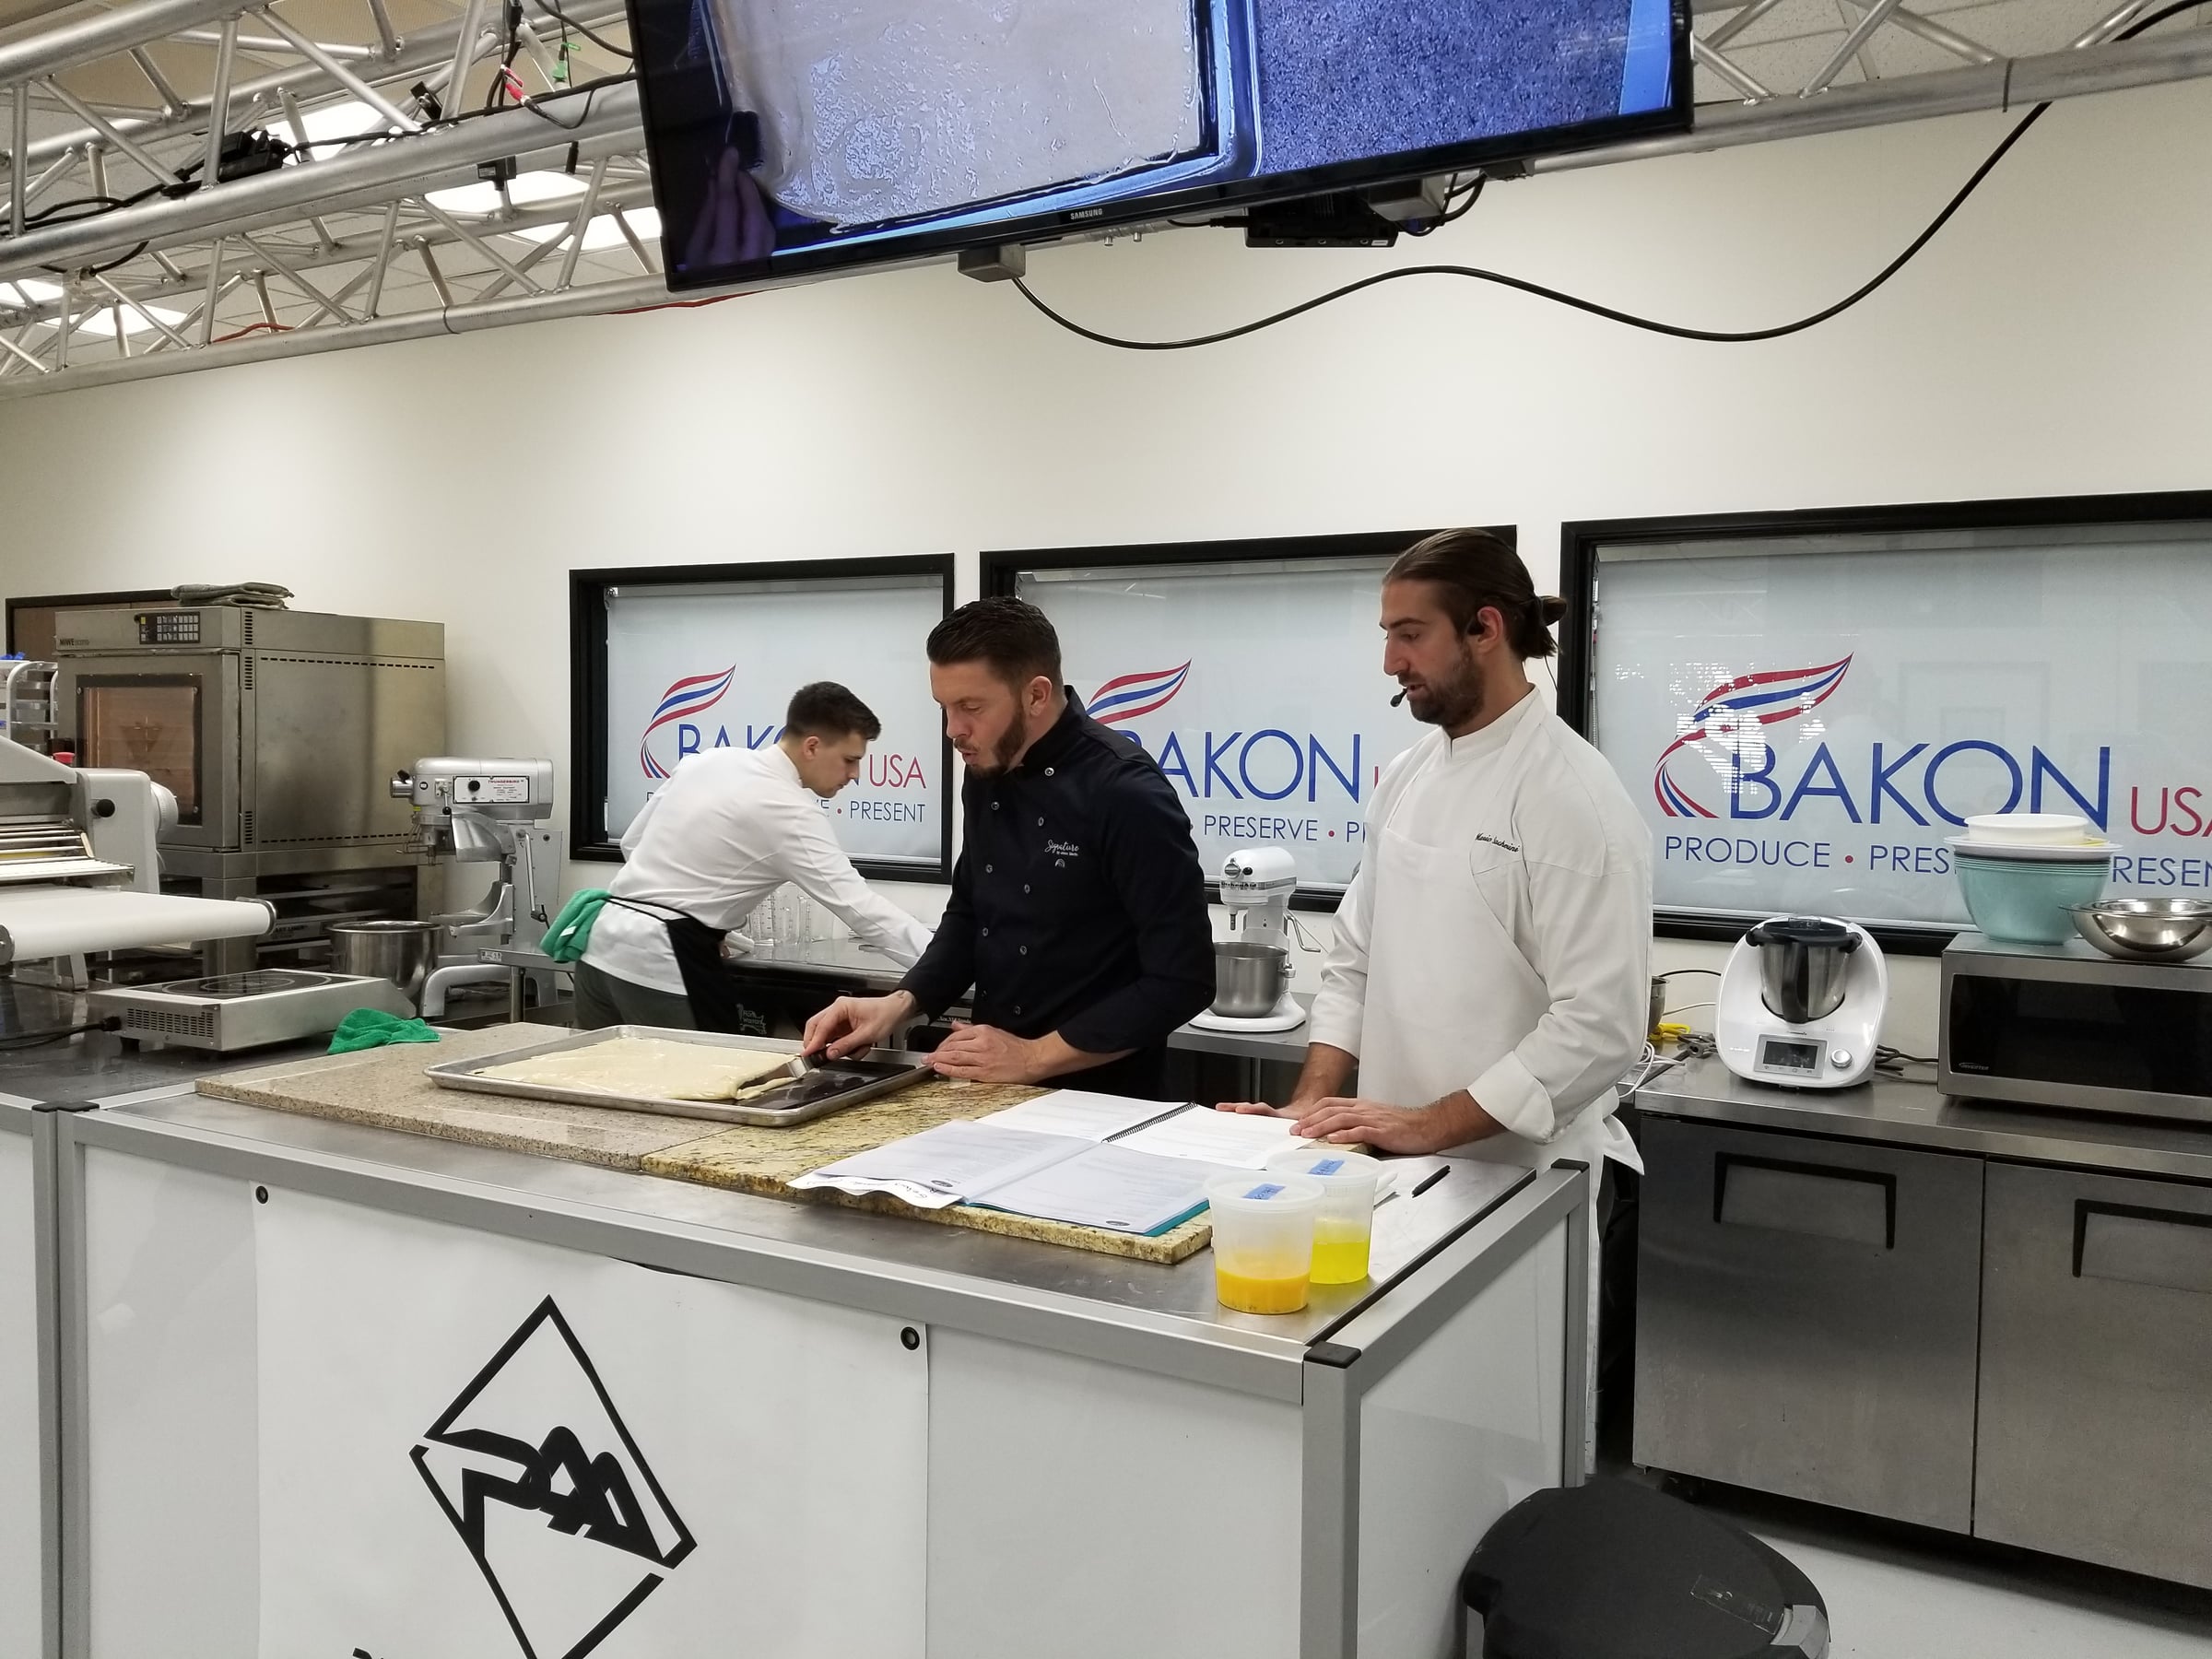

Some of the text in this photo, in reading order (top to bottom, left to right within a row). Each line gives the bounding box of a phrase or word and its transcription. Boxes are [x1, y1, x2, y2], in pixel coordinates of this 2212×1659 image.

[1070, 208, 1103, 220] SAMSUNG
[869, 754, 926, 789] USA
[1114, 729, 1361, 804] AKON
[1729, 739, 2111, 833] BAKON
[850, 800, 926, 823] PRESENT
[1204, 815, 1319, 841] PRESERVE
[1665, 836, 1831, 868] PRODUCE
[1870, 845, 1957, 875] PRES
